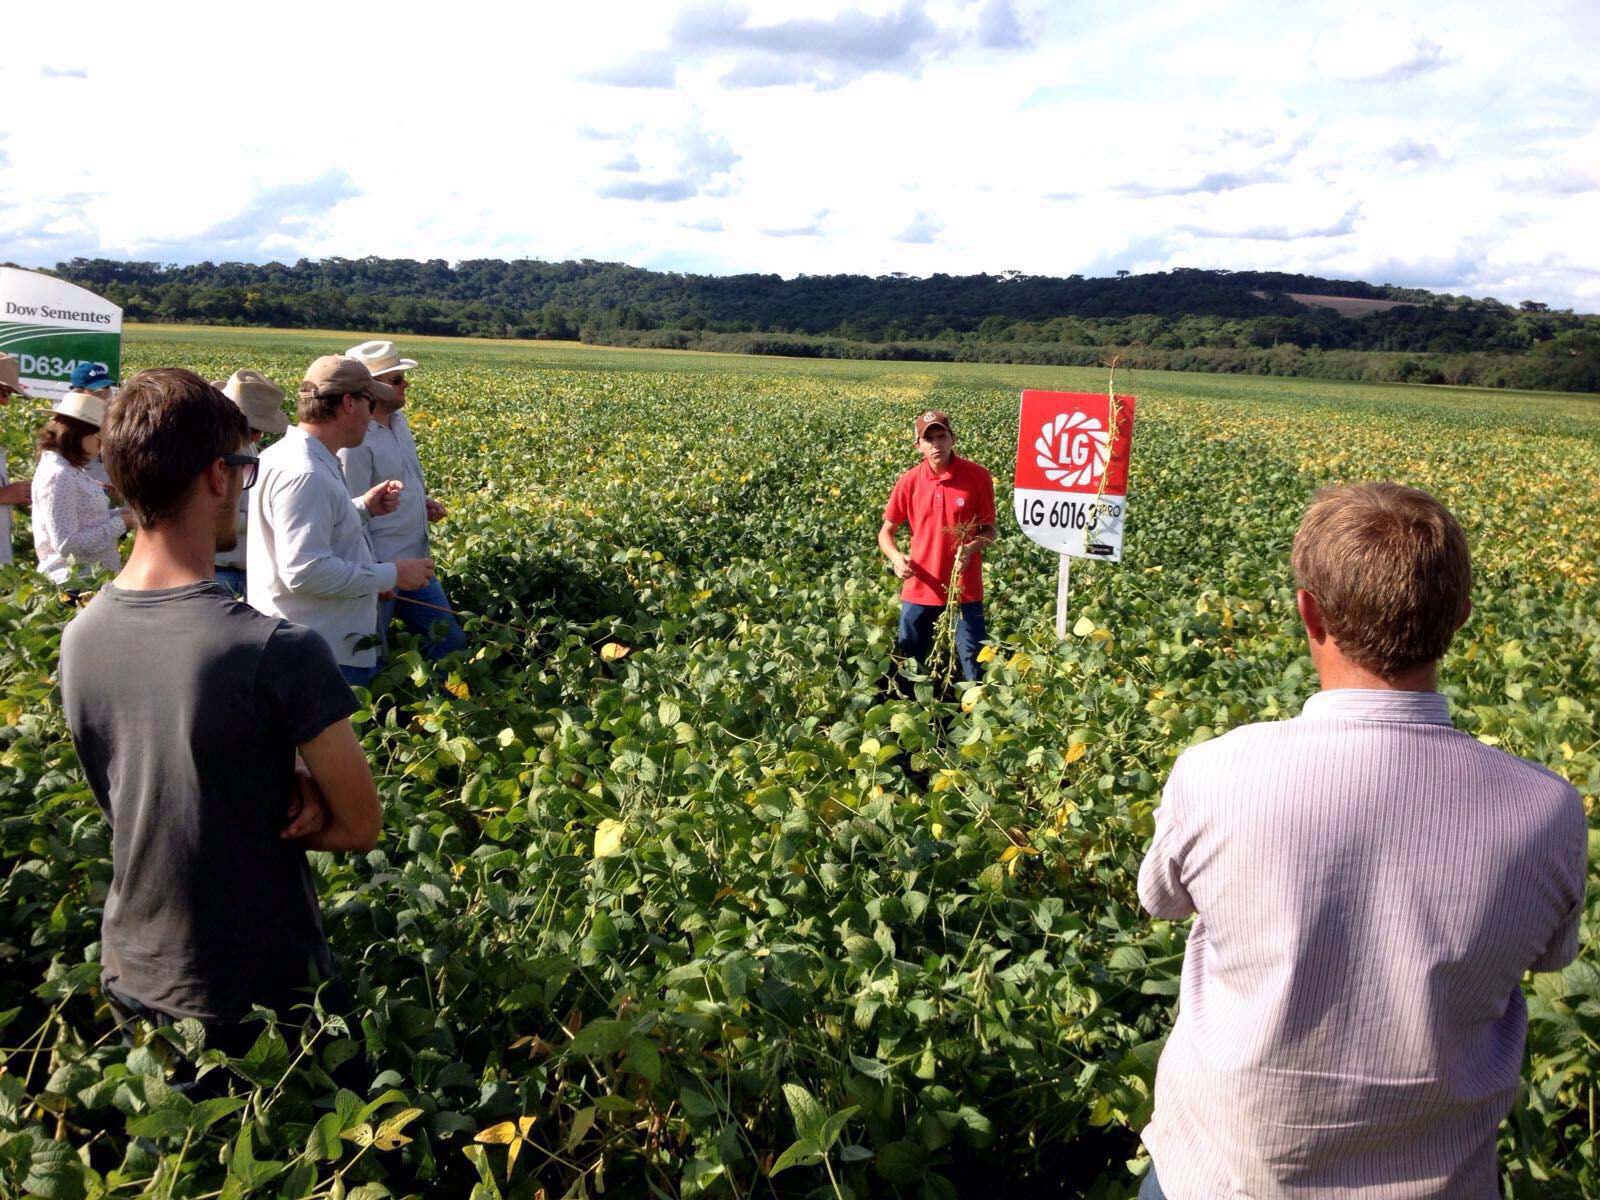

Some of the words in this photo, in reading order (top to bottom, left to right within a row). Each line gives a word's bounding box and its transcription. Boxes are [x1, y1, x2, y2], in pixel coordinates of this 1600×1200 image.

[5, 301, 38, 316] Dow
[41, 305, 111, 325] Sementes
[1058, 432, 1089, 466] LG
[1022, 498, 1045, 527] LG
